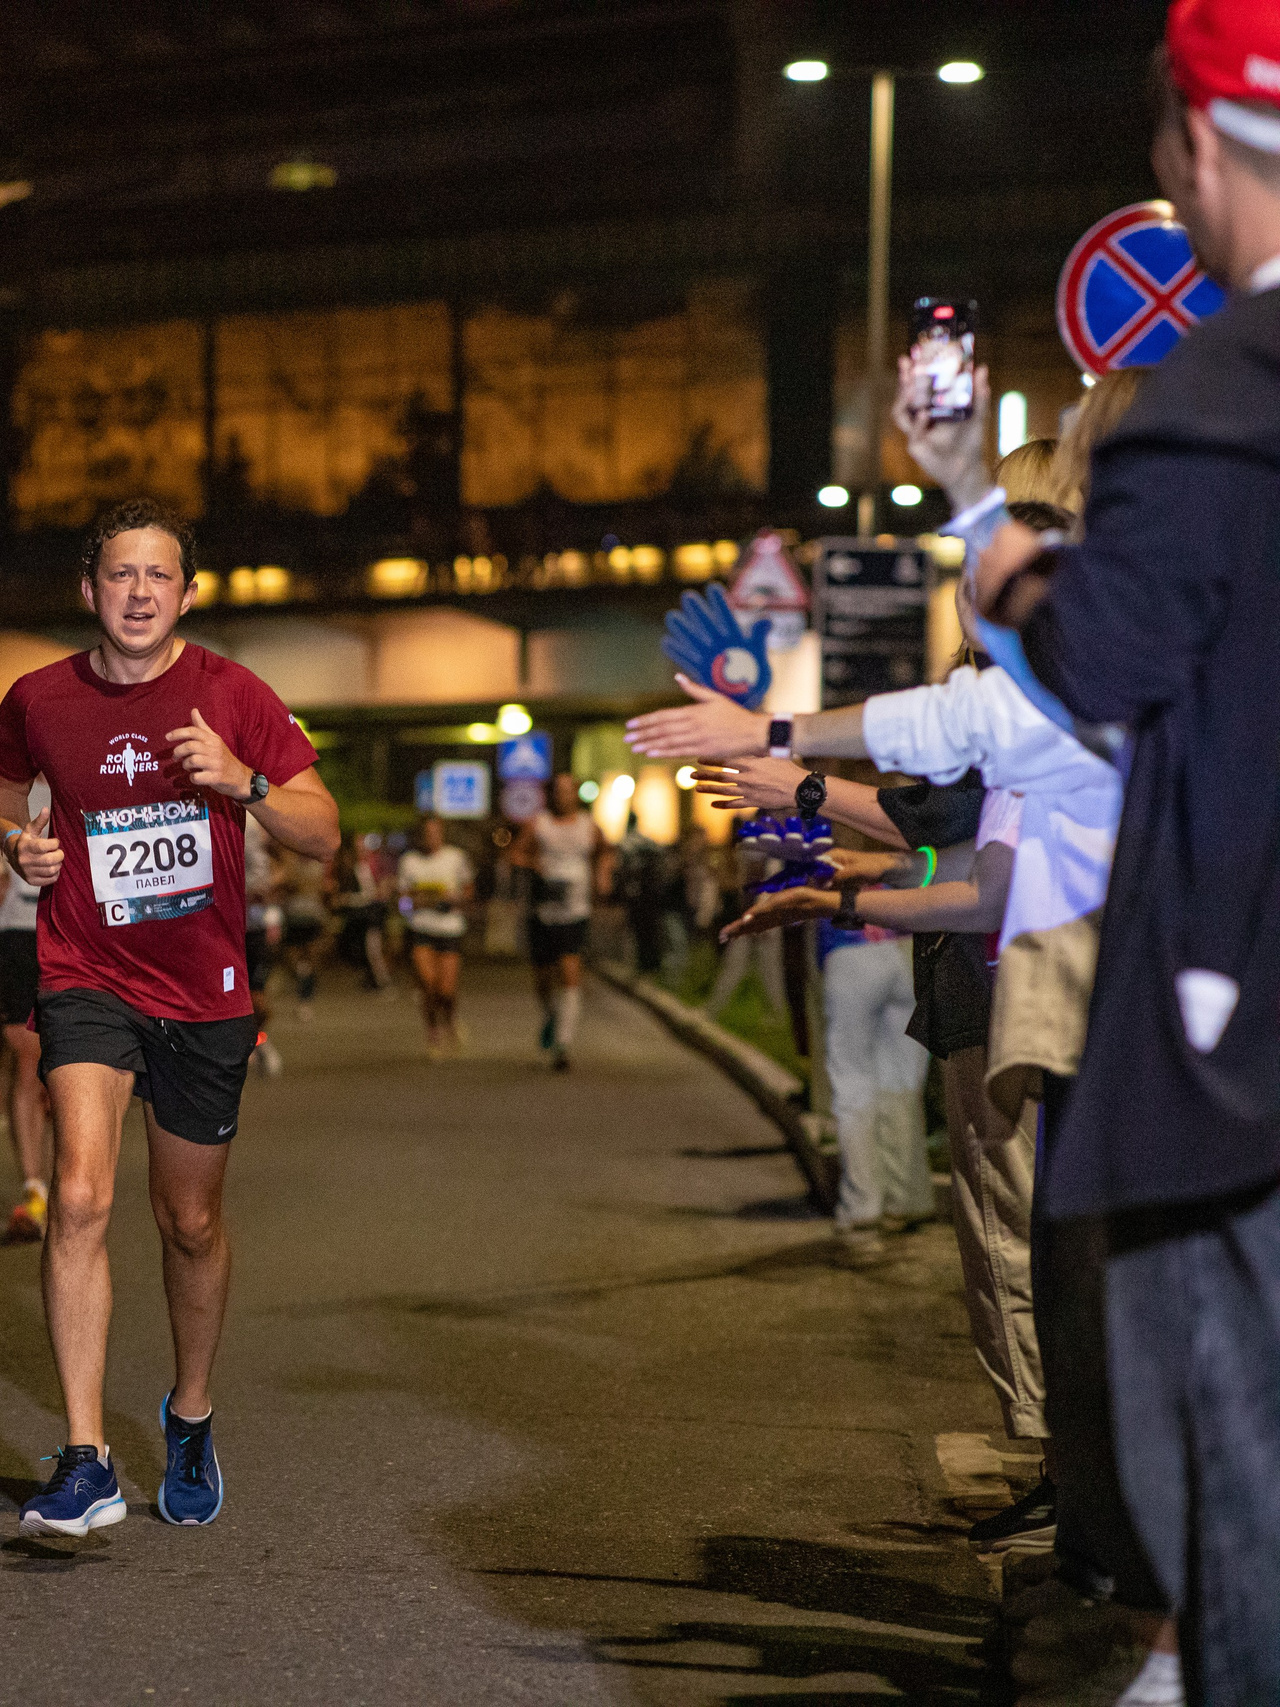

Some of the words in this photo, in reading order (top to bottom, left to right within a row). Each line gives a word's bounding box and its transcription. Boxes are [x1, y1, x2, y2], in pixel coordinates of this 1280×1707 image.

[106, 752, 151, 764] ROAD
[100, 761, 159, 774] RUNNERS
[106, 833, 199, 879] 2208
[135, 874, 175, 889] ПАВЕЛ
